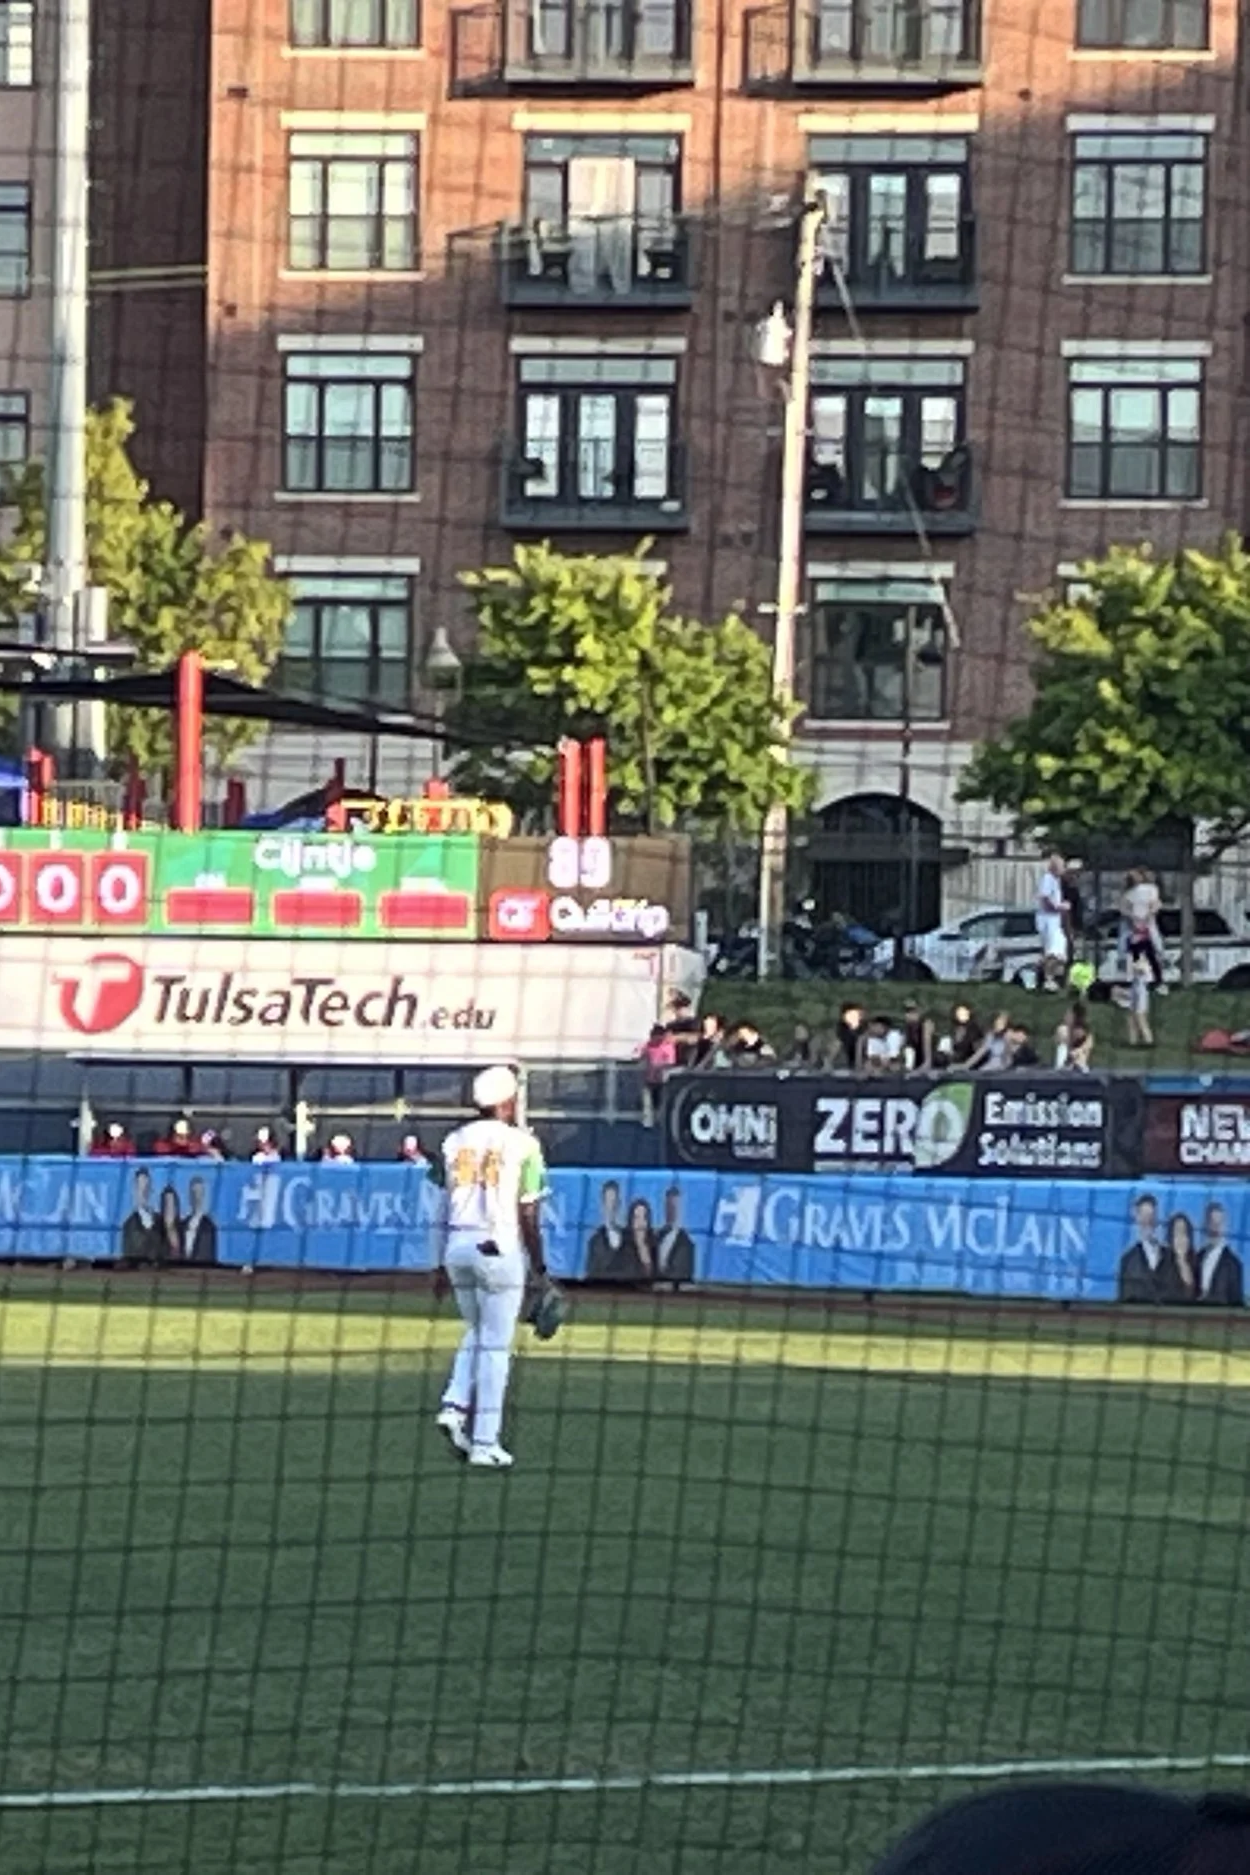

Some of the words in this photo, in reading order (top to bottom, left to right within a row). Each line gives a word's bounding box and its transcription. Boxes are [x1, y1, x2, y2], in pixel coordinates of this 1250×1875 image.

[37, 864, 78, 913] 0
[100, 865, 140, 913] 0
[814, 1098, 964, 1156] ZERO
[984, 1092, 1102, 1126] Emission
[978, 1133, 1101, 1167] Solutions
